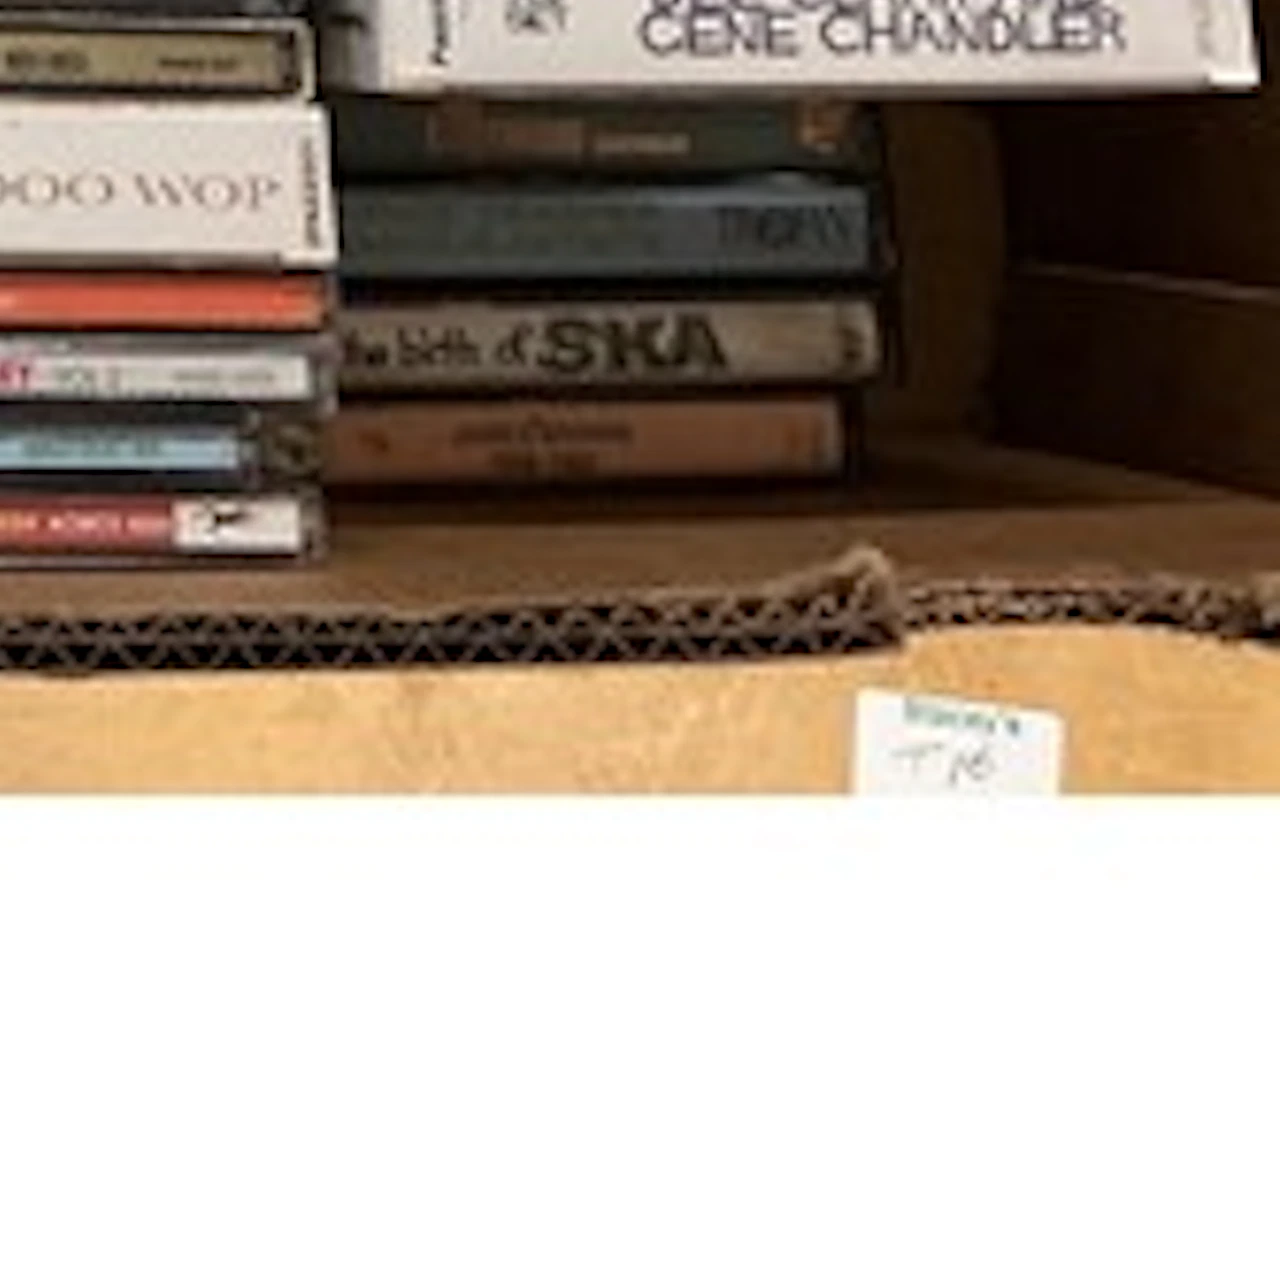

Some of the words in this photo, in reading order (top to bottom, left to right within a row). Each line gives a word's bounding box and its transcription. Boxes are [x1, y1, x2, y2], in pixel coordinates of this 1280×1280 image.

[638, 11, 798, 57] GENE
[820, 7, 1127, 53] CHANDLER
[133, 173, 283, 207] WOP
[397, 324, 481, 368] birth
[494, 324, 533, 368] of
[537, 315, 731, 375] SKA
